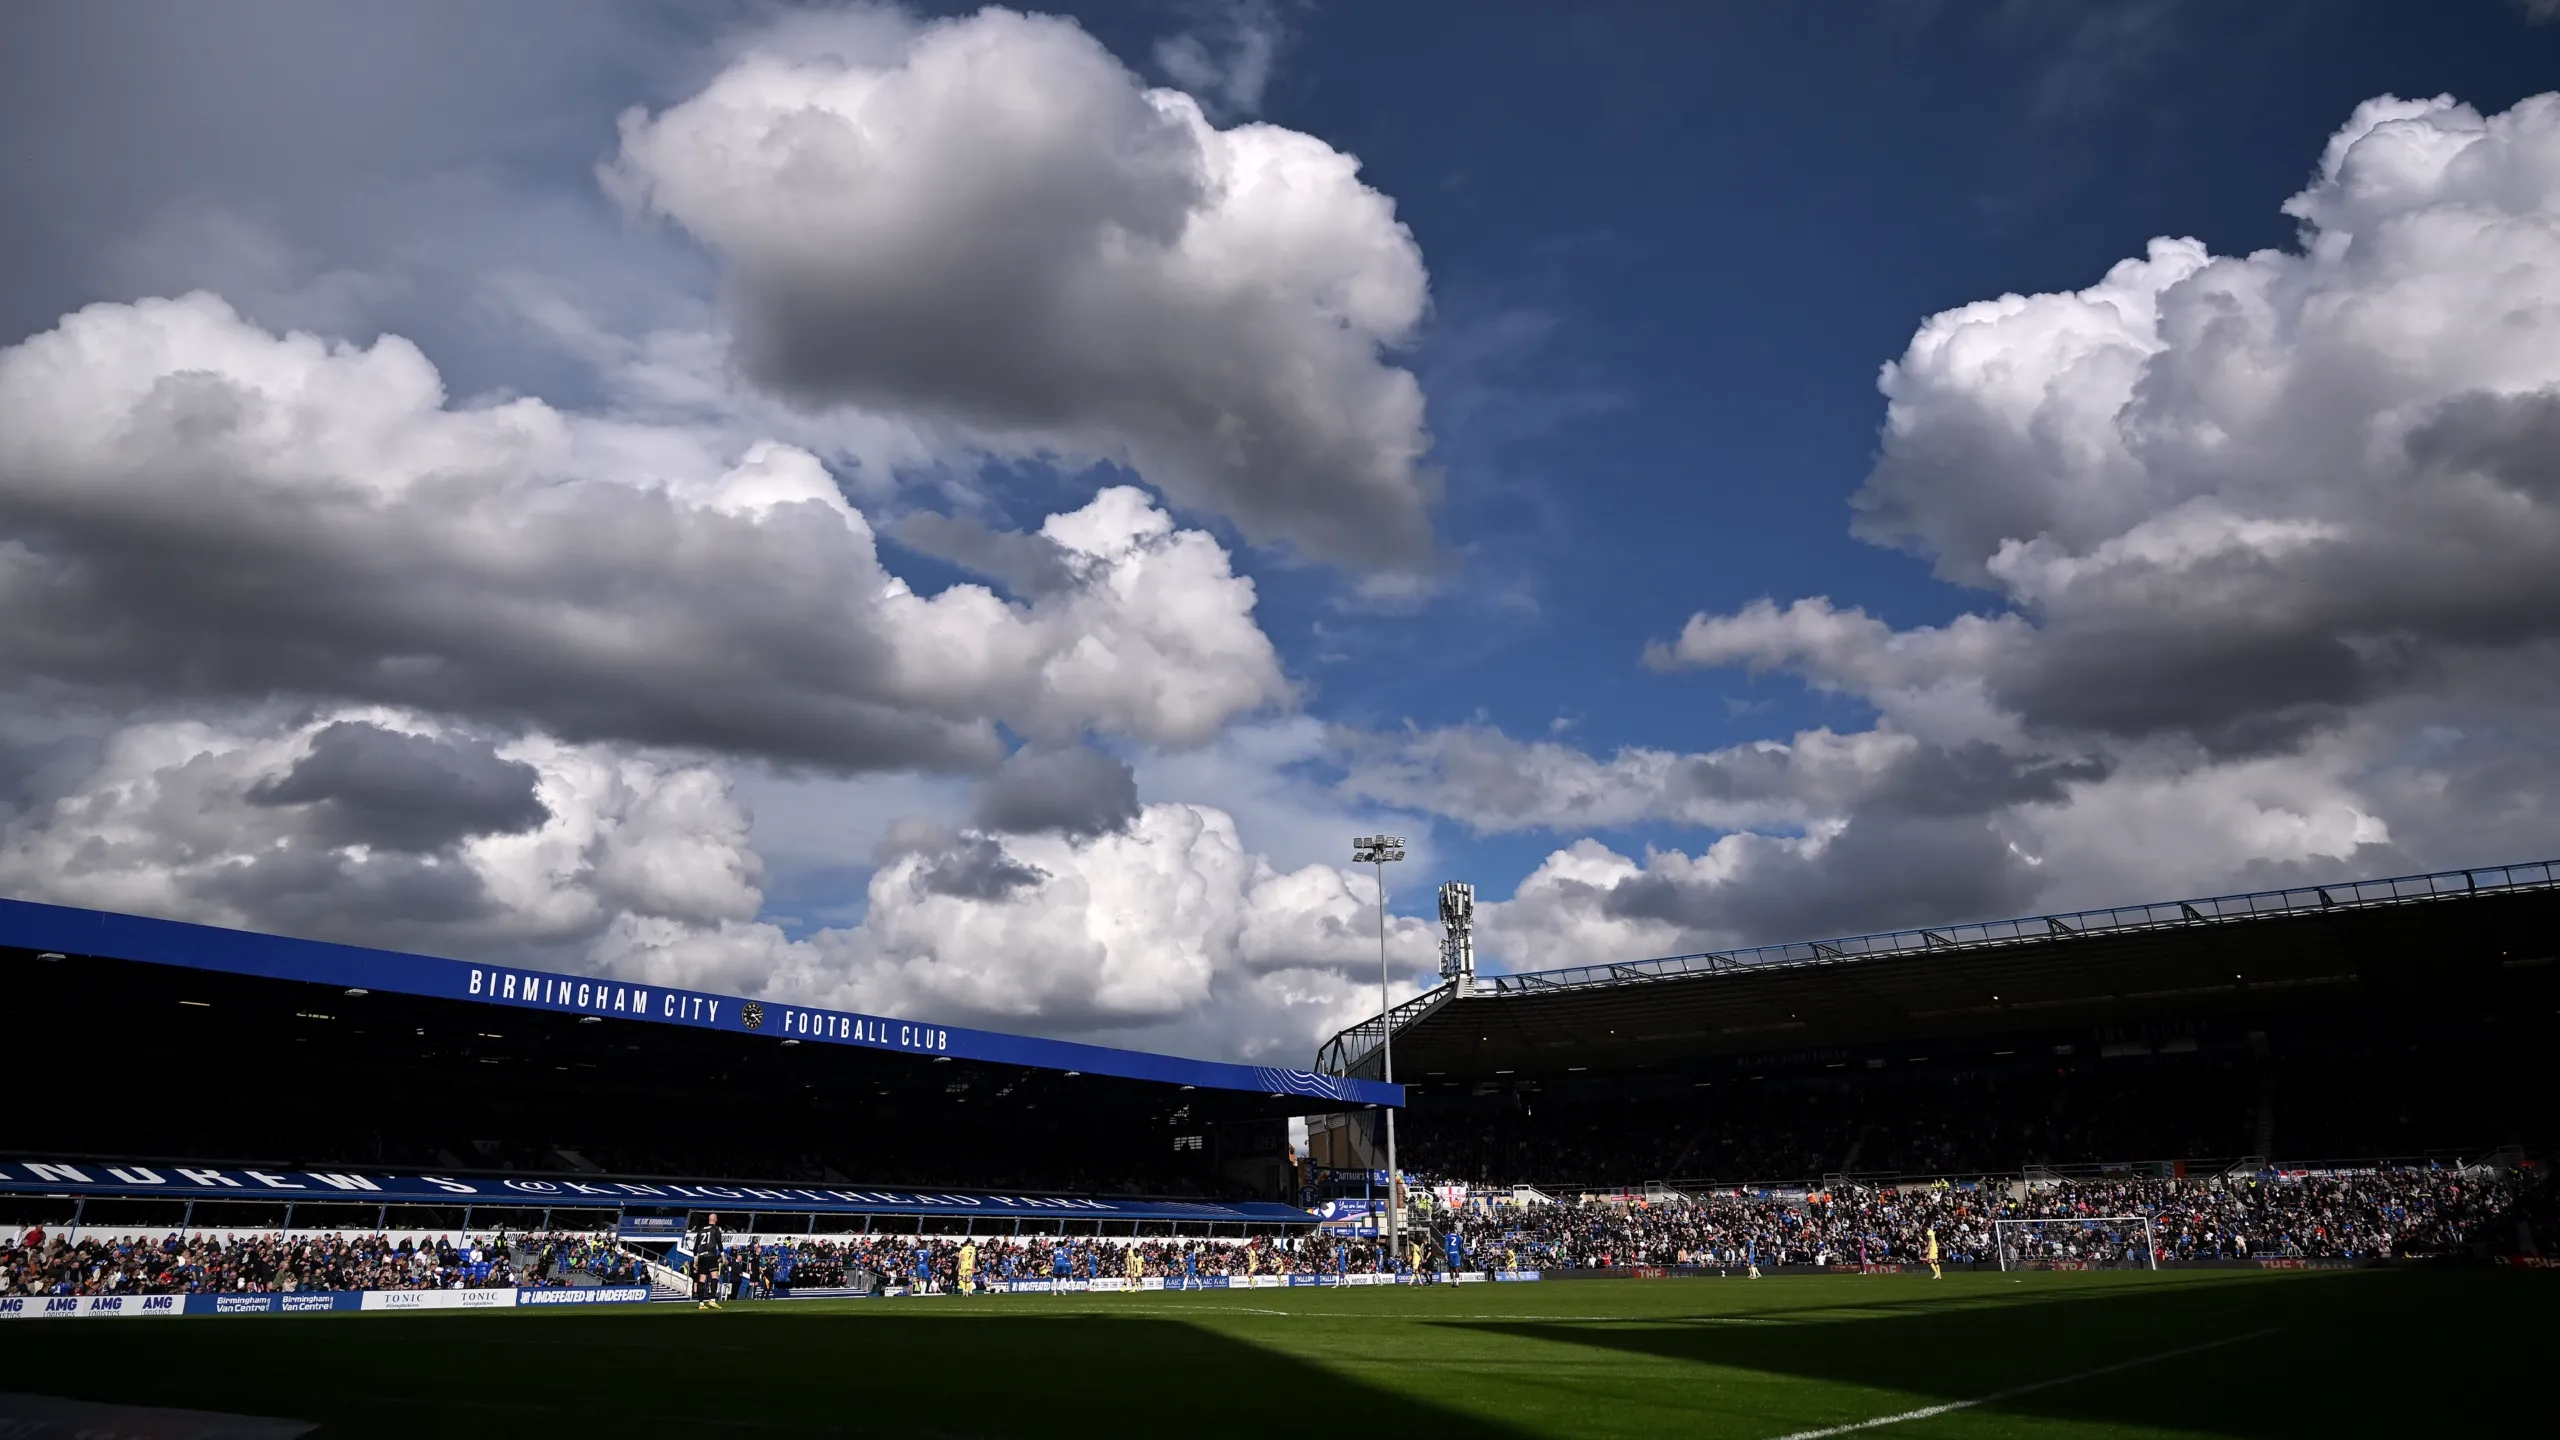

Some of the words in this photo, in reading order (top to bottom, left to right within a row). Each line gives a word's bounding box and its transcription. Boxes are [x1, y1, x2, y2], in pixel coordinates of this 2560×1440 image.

[469, 969, 647, 1014] BIRMINGHAM
[664, 994, 719, 1022] CITY
[784, 1010, 888, 1044] FOOTBALL
[901, 1026, 948, 1050] CLUB
[0, 1163, 478, 1194] NDREW'S
[989, 1196, 1119, 1209] PARK
[700, 1232, 711, 1245] 21
[1451, 1236, 1457, 1246] 2
[919, 1253, 924, 1262] 5
[968, 1252, 973, 1261] 7
[1638, 1269, 1662, 1278] THE
[216, 1297, 267, 1305] Birmingham
[282, 1296, 330, 1304] Birmingham
[384, 1294, 424, 1303] TONIC
[461, 1292, 498, 1301] TONIC
[532, 1290, 585, 1304] UNDEFEATED
[596, 1289, 647, 1301] UNDEFEATED
[0, 1298, 24, 1312] MG
[45, 1298, 78, 1311] AMG
[90, 1297, 123, 1310] AMG
[142, 1296, 173, 1309] AMG
[281, 1303, 298, 1311] Van
[299, 1303, 329, 1311] Centre
[216, 1304, 234, 1312] Van
[234, 1304, 265, 1312] Centre
